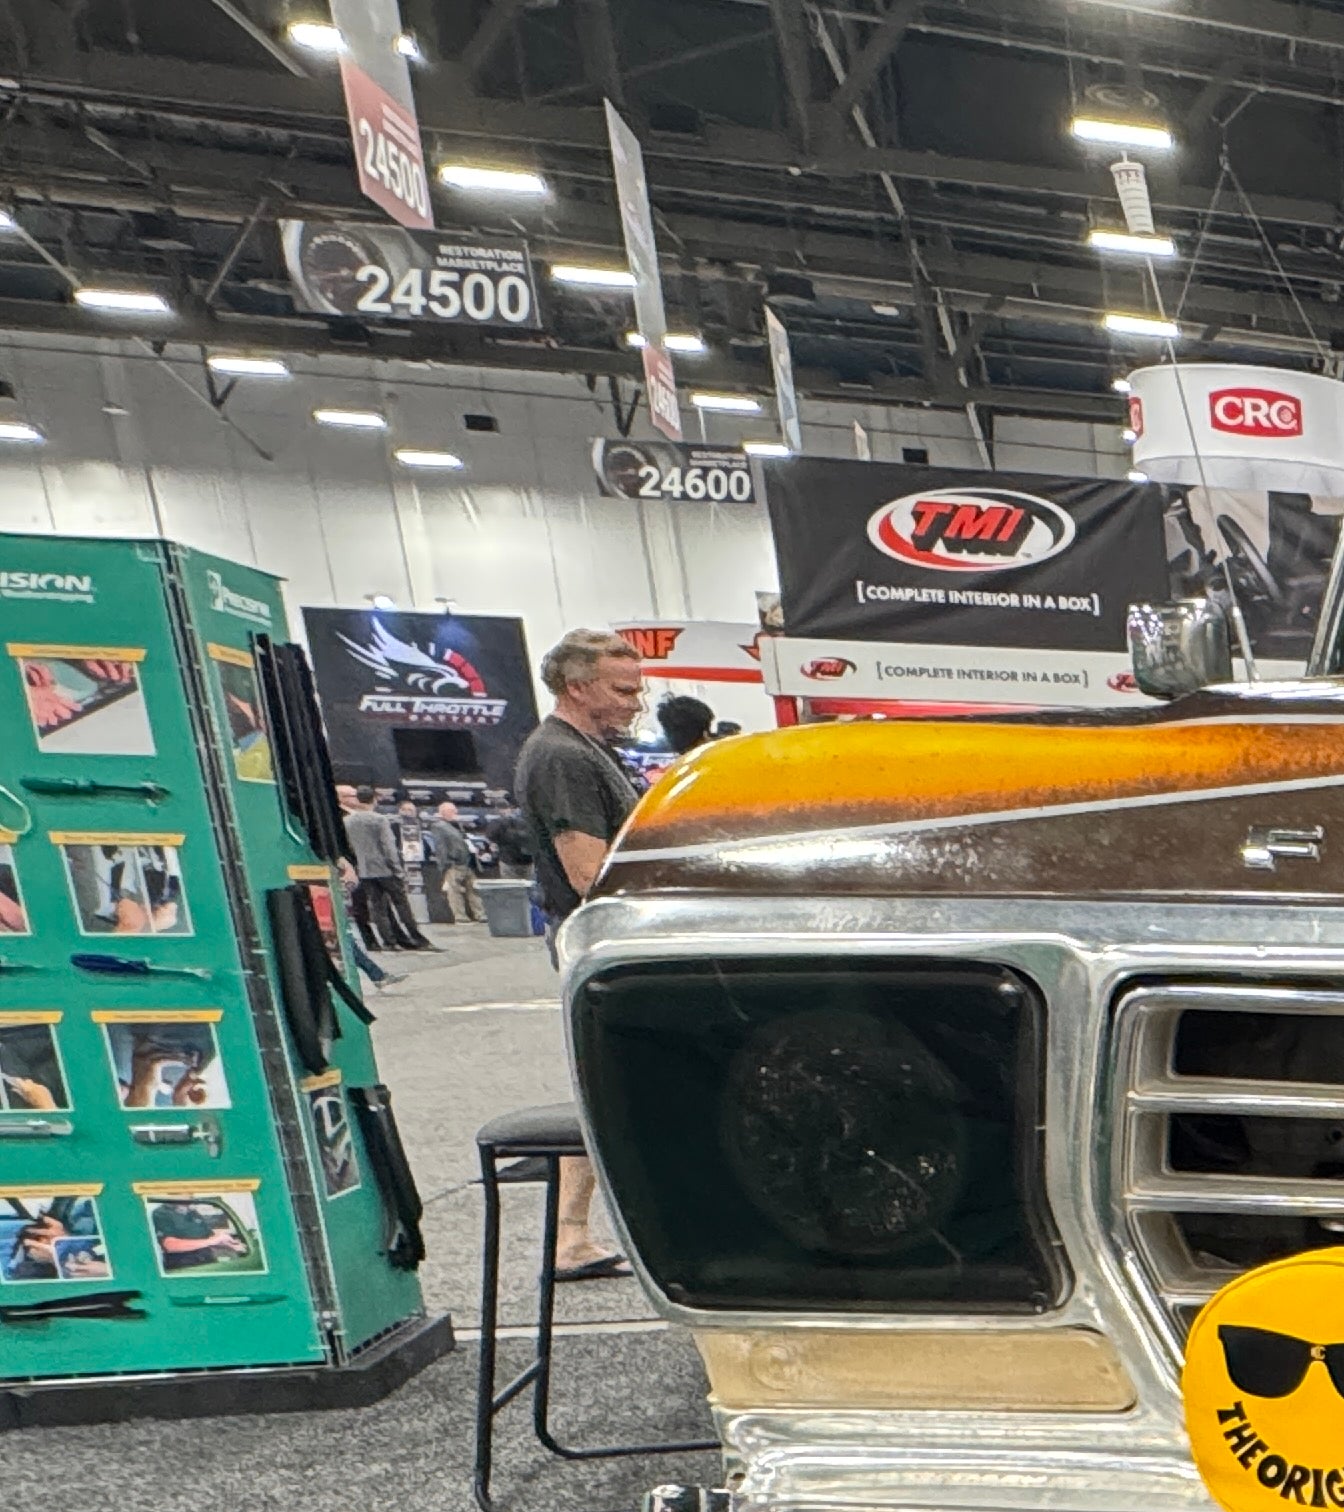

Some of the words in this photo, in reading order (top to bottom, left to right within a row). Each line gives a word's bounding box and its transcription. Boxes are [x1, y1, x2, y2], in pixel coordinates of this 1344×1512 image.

[358, 117, 428, 219] 24500
[356, 265, 530, 323] 24500
[1214, 396, 1298, 431] CRC
[638, 464, 751, 501] 24600
[911, 501, 1035, 557] TMI
[948, 589, 1021, 609] INTERIOR
[1023, 593, 1042, 609] IN
[1044, 596, 1057, 611] A
[956, 669, 1018, 682] INTERIOR
[1021, 672, 1038, 683] IN
[1040, 672, 1051, 684] A
[1216, 1401, 1269, 1471] THE
